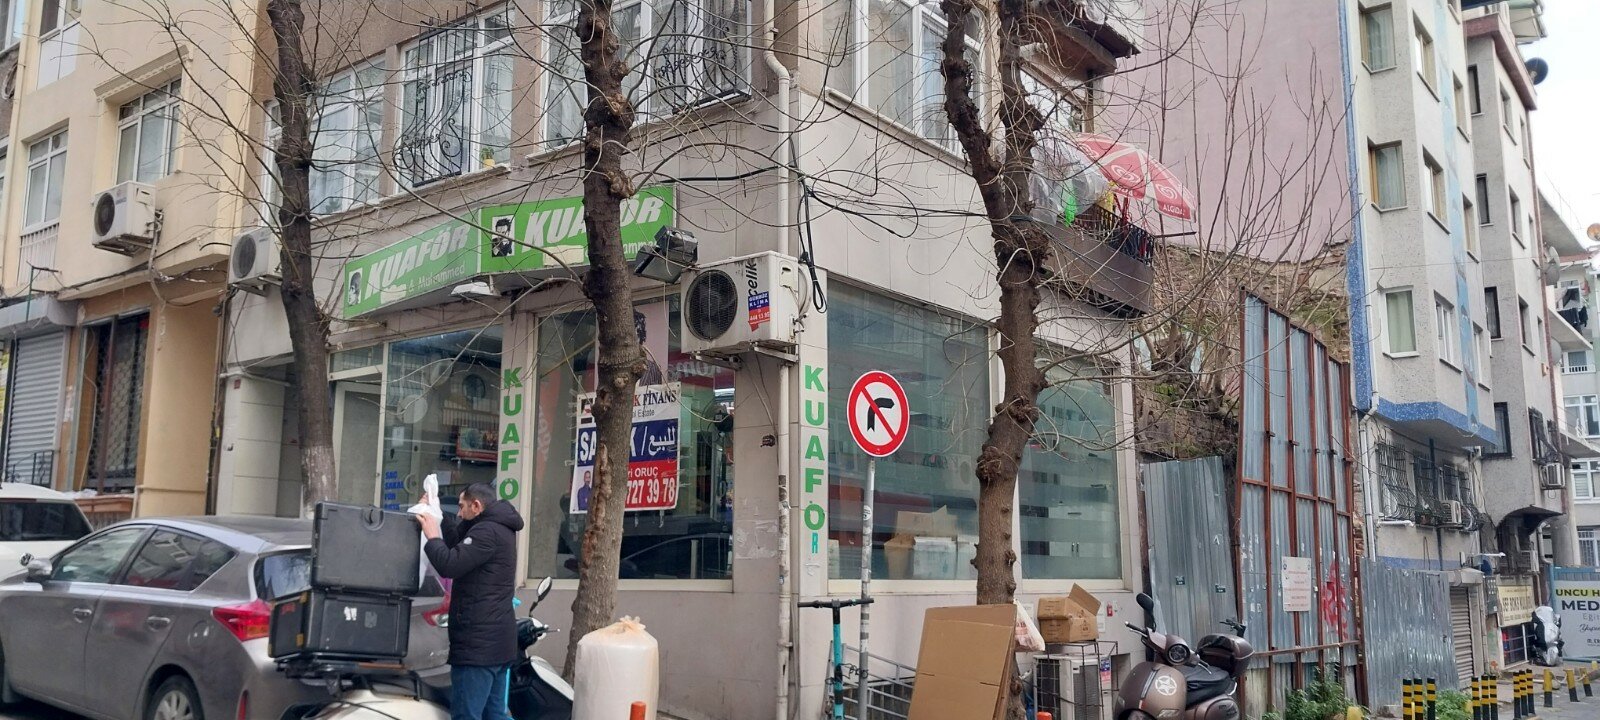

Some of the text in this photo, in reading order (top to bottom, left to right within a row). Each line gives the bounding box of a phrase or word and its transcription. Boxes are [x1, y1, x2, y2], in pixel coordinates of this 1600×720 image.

[522, 195, 665, 253] KUAÖR
[364, 224, 471, 300] KUAFÖR
[643, 390, 677, 406] FİNANS
[500, 367, 523, 500] KUAFÖ
[634, 466, 659, 479] ORUÇ
[626, 477, 676, 504] 727 39 78
[1555, 589, 1588, 597] UNCU
[1562, 600, 1600, 611] MED
